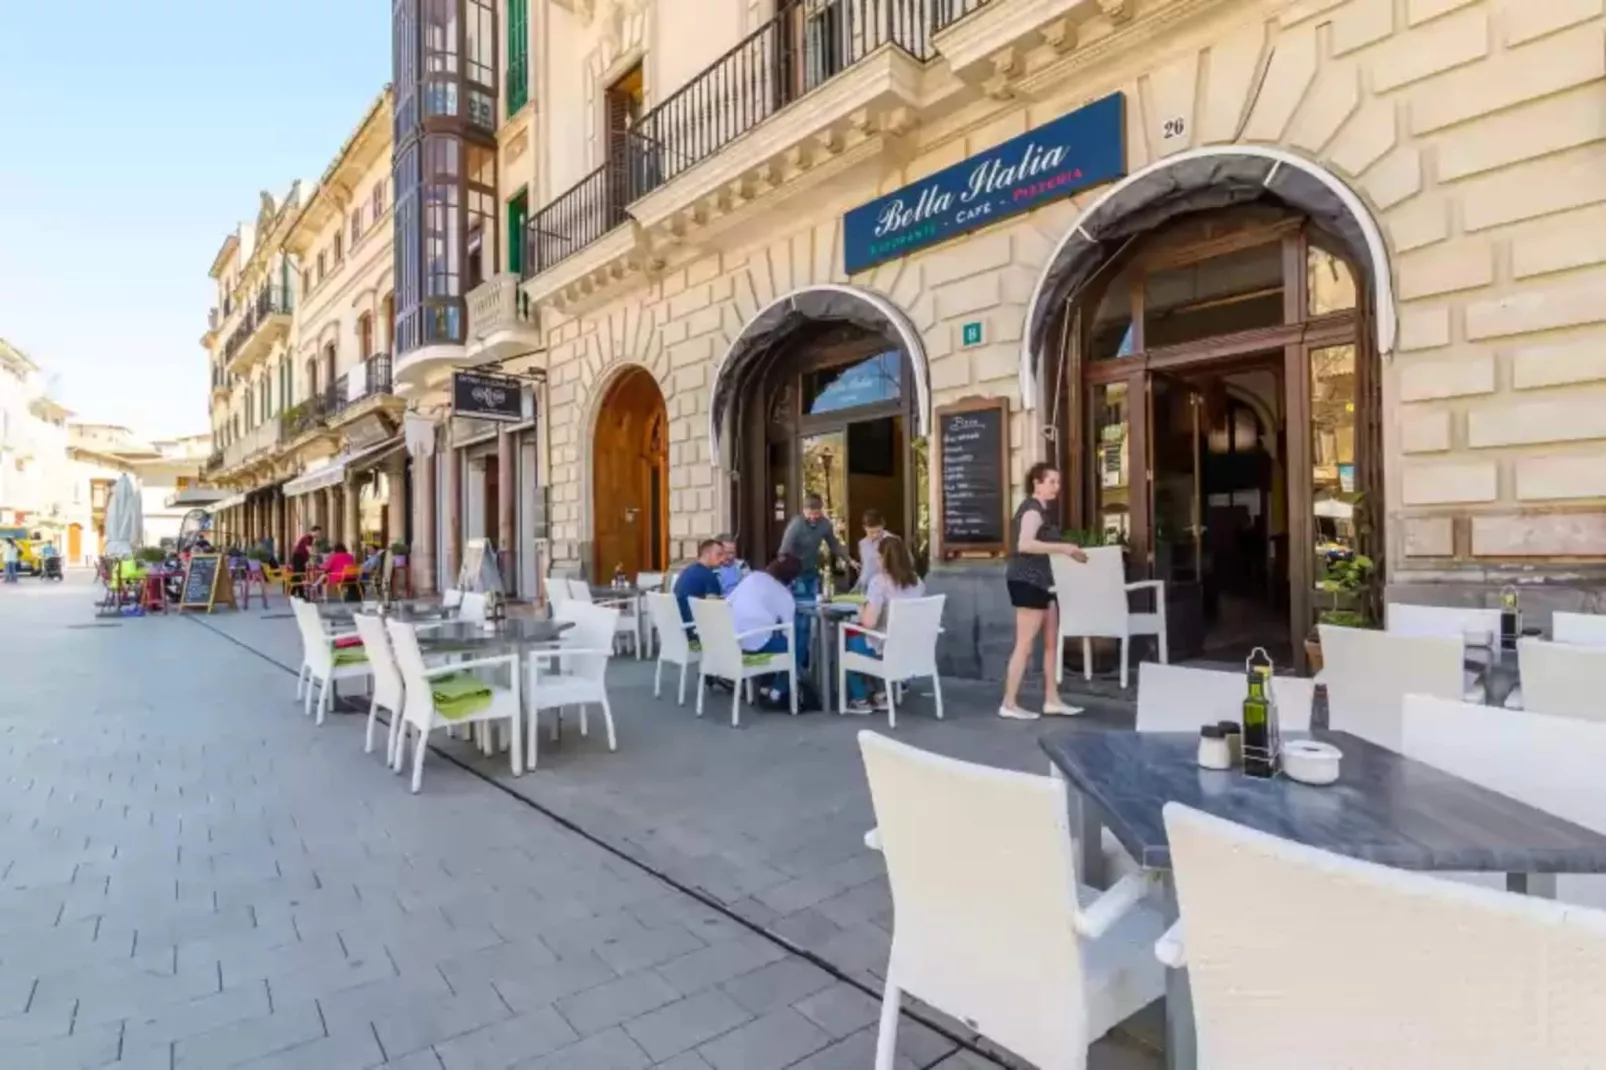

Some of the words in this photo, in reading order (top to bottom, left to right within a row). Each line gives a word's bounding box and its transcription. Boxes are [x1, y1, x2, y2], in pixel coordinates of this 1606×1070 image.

[1163, 116, 1185, 139] 26
[874, 184, 956, 238] Bella
[959, 141, 1071, 203] Italia
